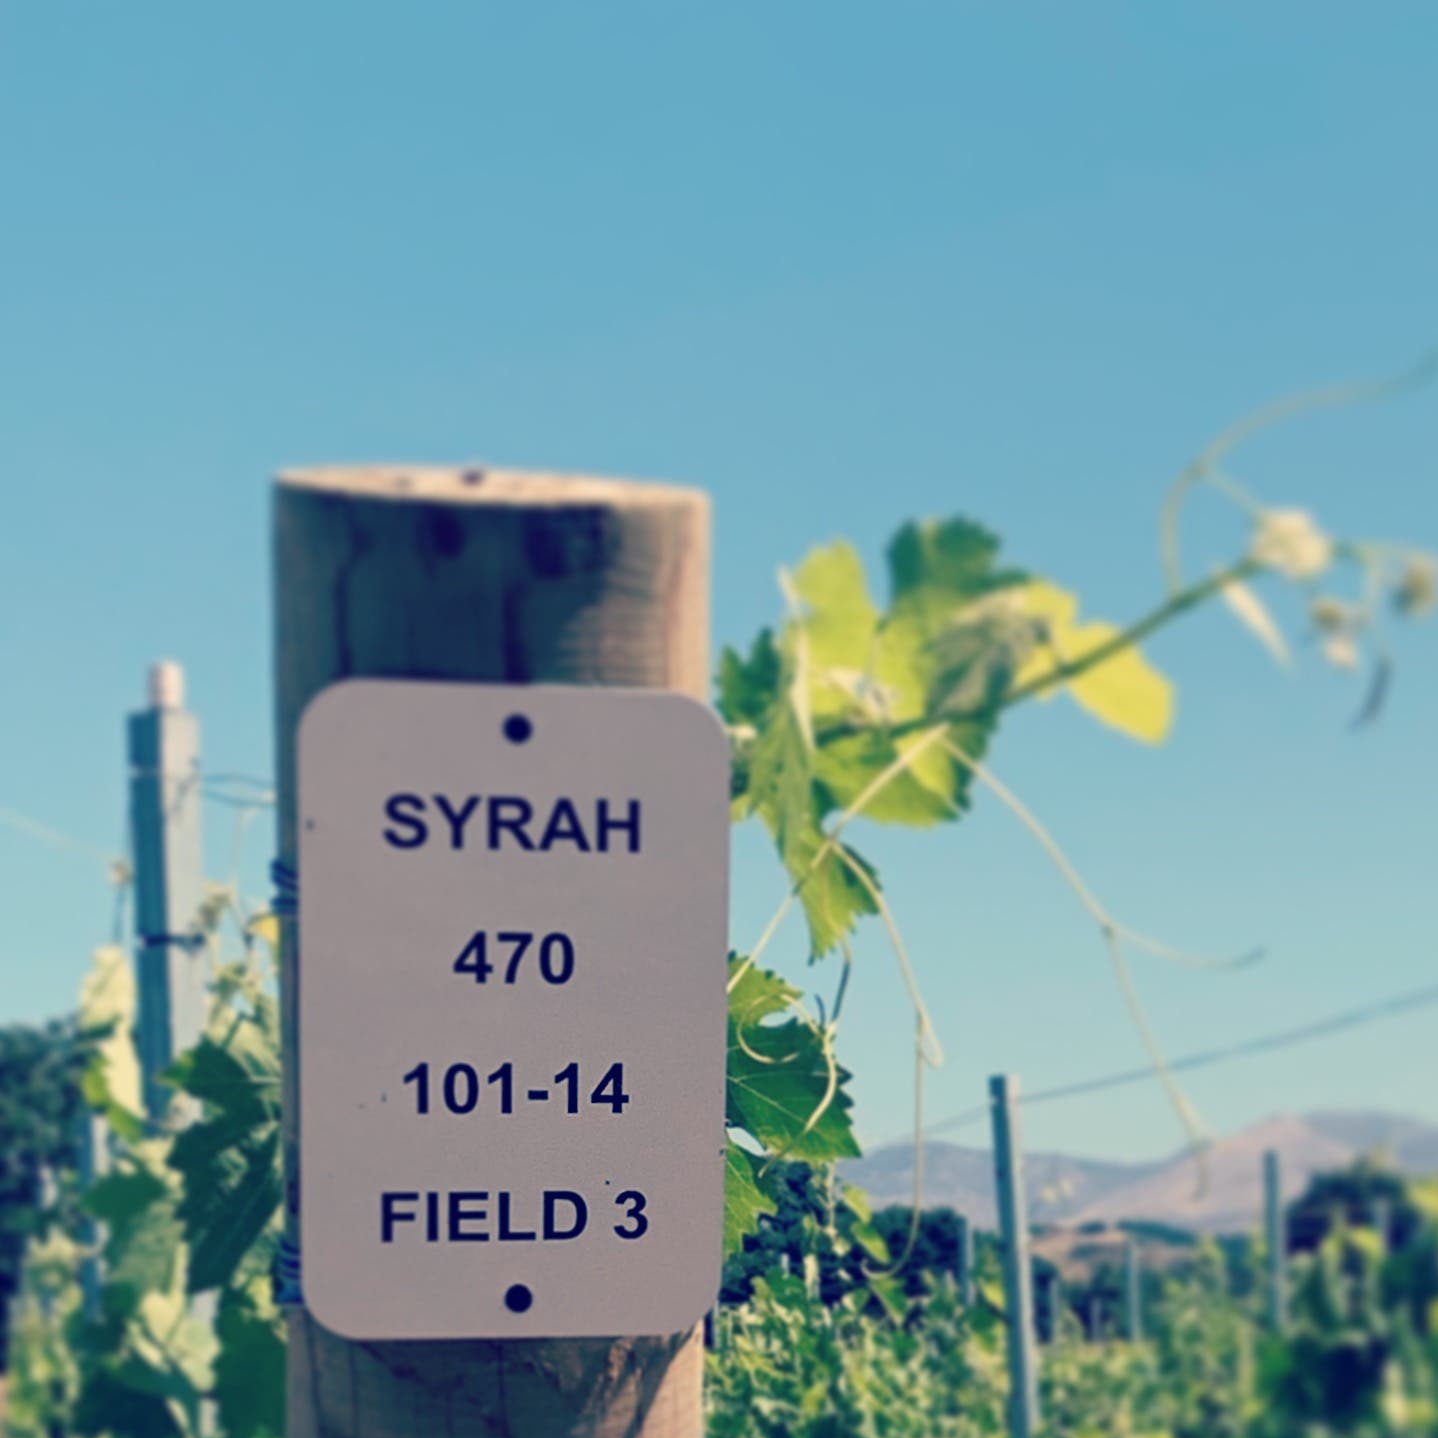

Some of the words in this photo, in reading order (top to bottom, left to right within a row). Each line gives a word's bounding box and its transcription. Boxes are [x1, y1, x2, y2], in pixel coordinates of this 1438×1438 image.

[382, 792, 642, 854] SYRAH
[452, 930, 576, 986] 470
[402, 1061, 631, 1115] 101-14
[379, 1190, 589, 1244] FIELD
[612, 1188, 650, 1241] 3
